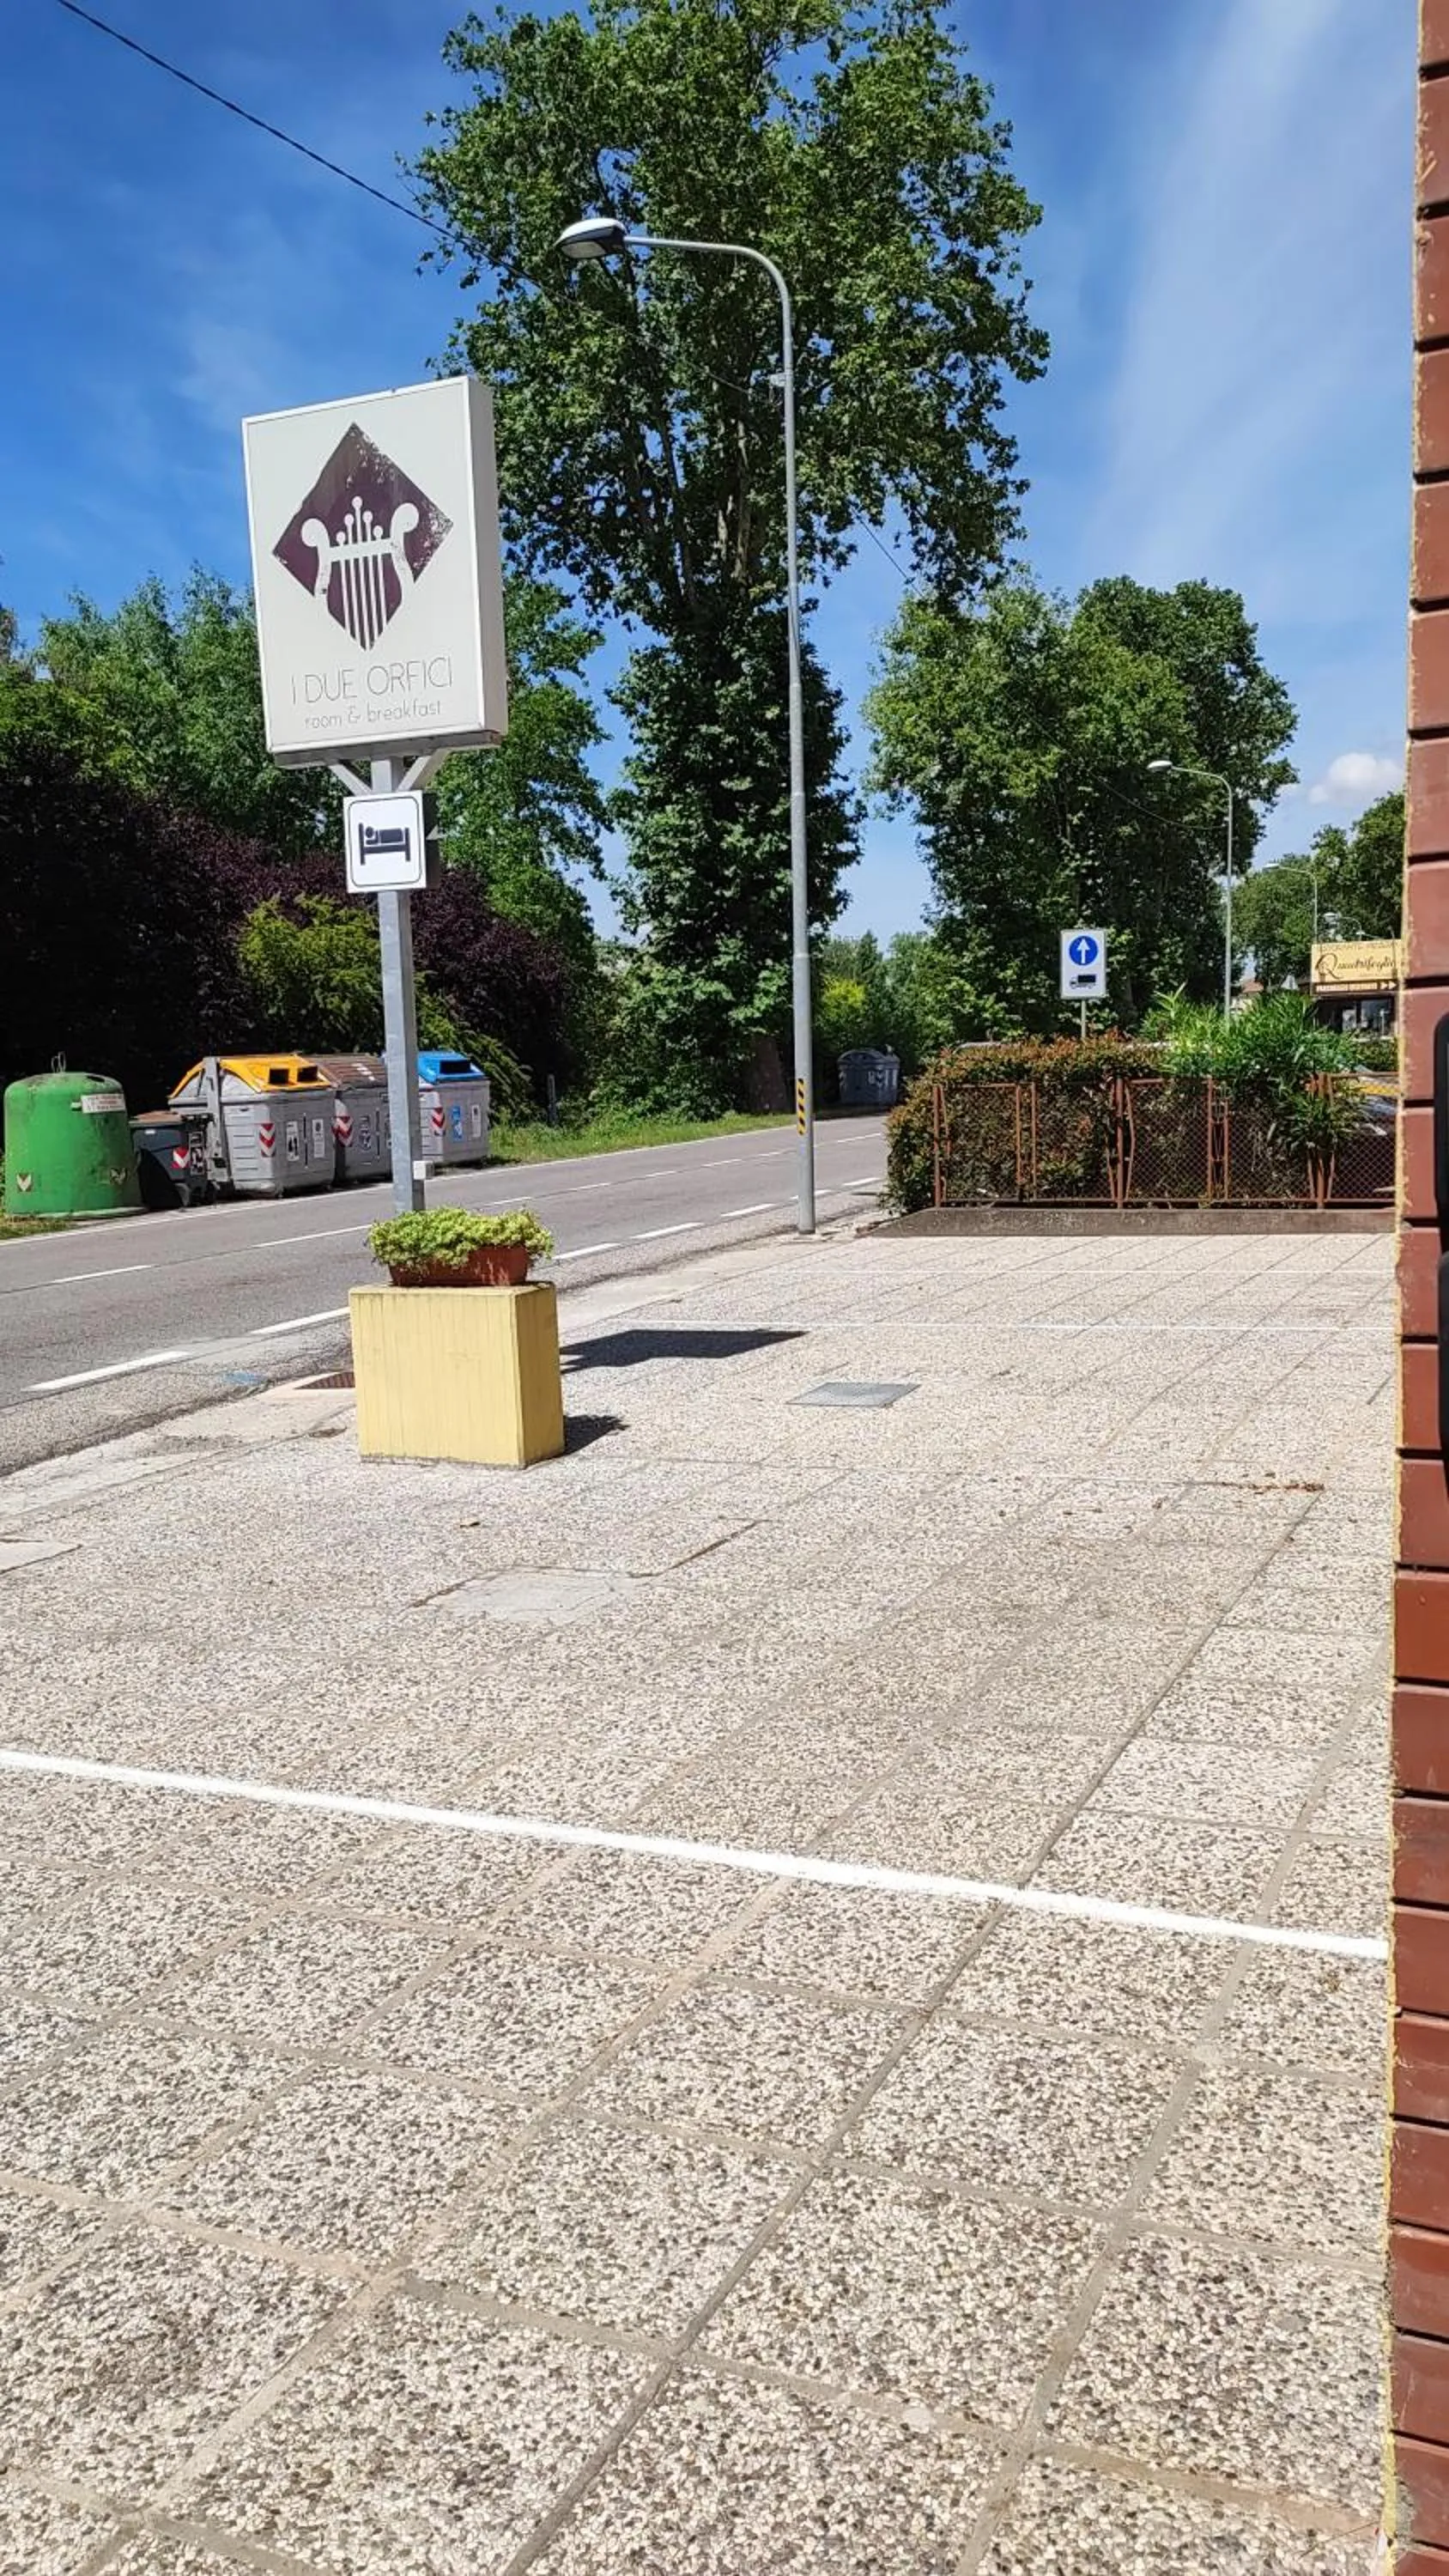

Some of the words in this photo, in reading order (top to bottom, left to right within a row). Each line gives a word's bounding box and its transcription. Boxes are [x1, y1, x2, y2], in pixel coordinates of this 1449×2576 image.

[291, 674, 297, 705] I
[304, 669, 358, 703] DUE
[367, 656, 453, 696] ORFICI
[304, 714, 343, 729] room
[348, 705, 361, 725] &
[367, 698, 441, 723] breakfast
